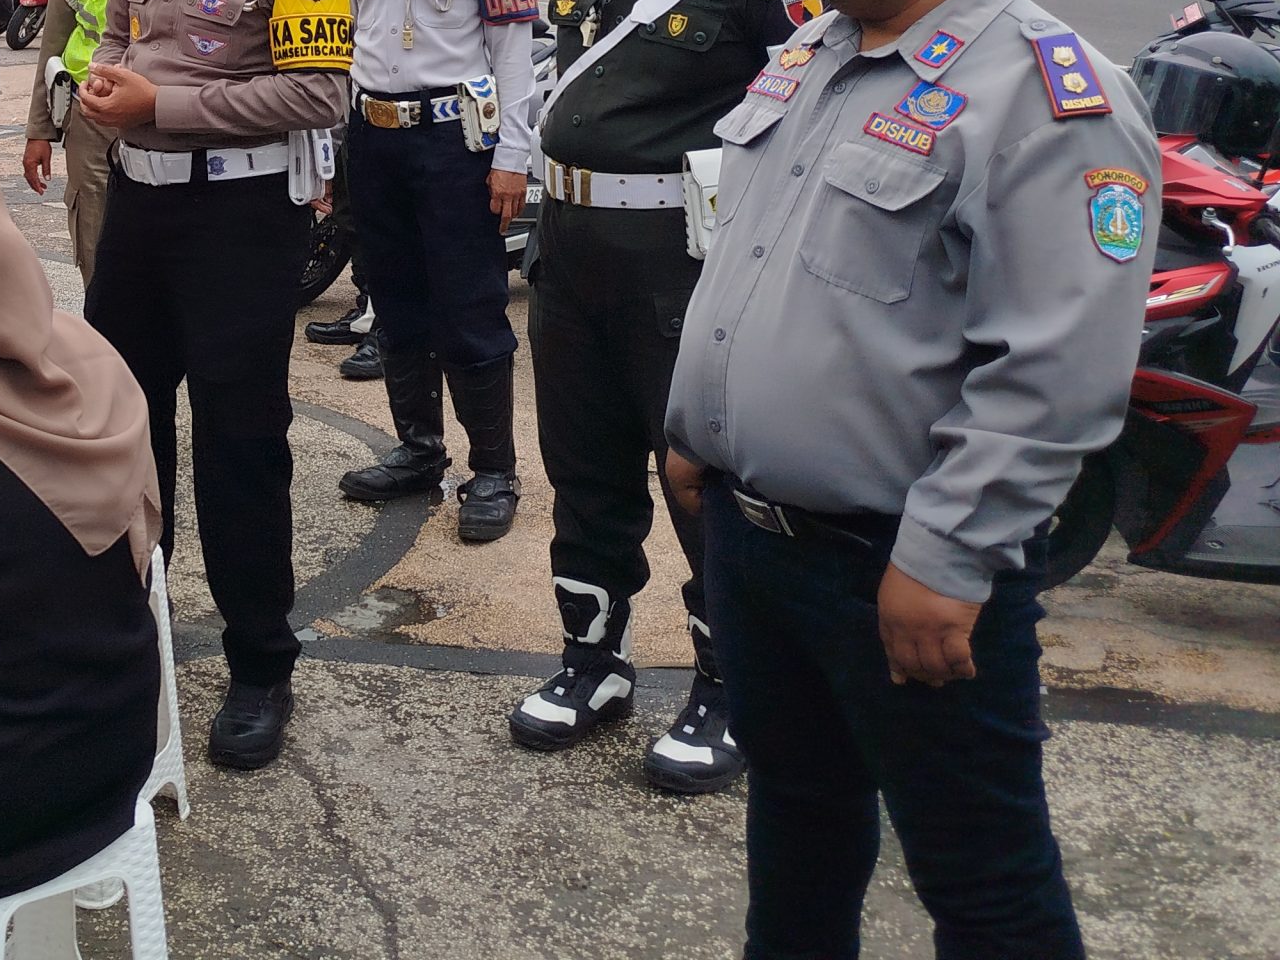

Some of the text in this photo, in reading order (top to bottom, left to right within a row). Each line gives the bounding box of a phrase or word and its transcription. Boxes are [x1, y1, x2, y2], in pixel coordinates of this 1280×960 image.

[272, 20, 294, 48] KA
[870, 117, 931, 150] DISHUB
[1089, 172, 1144, 190] PONOROGO
